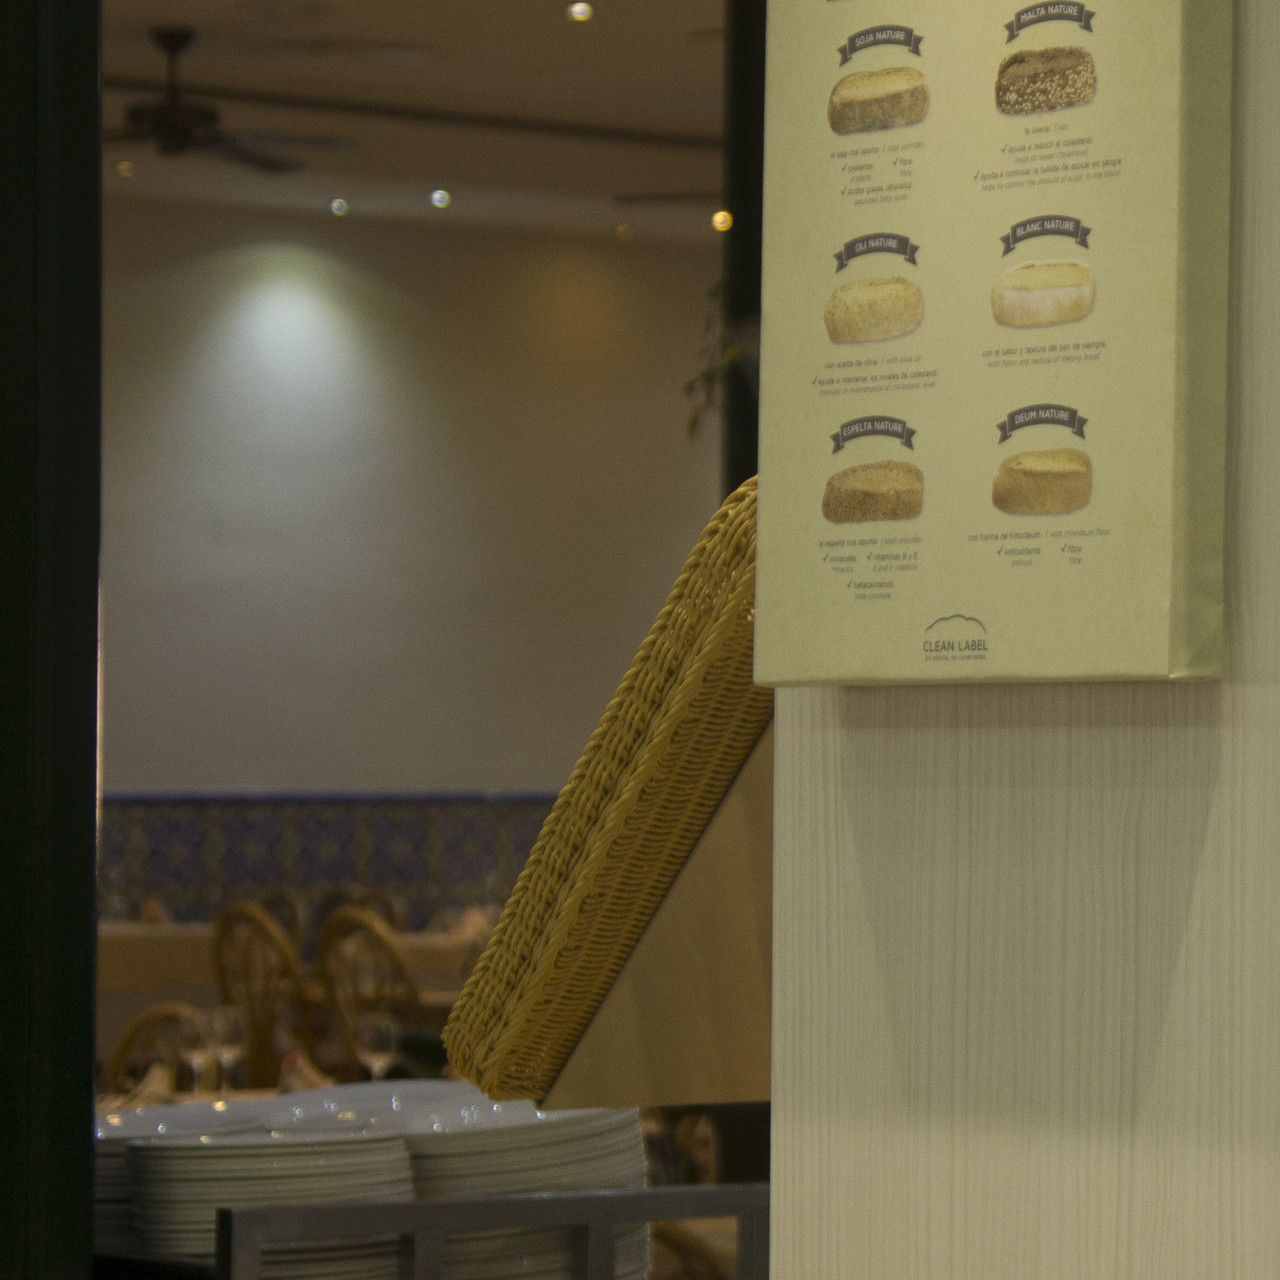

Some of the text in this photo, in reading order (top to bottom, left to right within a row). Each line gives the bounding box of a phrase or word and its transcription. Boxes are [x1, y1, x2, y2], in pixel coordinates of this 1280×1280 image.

[1020, 4, 1078, 21] MALTA NATURE
[855, 29, 906, 47] SOJA NATURE
[1015, 219, 1075, 236] BLANC NATURE
[854, 237, 897, 253] OLI NATURE
[1014, 408, 1069, 424] DEUM NATURE
[842, 420, 904, 437] ESPELTA NATURE
[923, 639, 988, 652] CLEAN LABEL
